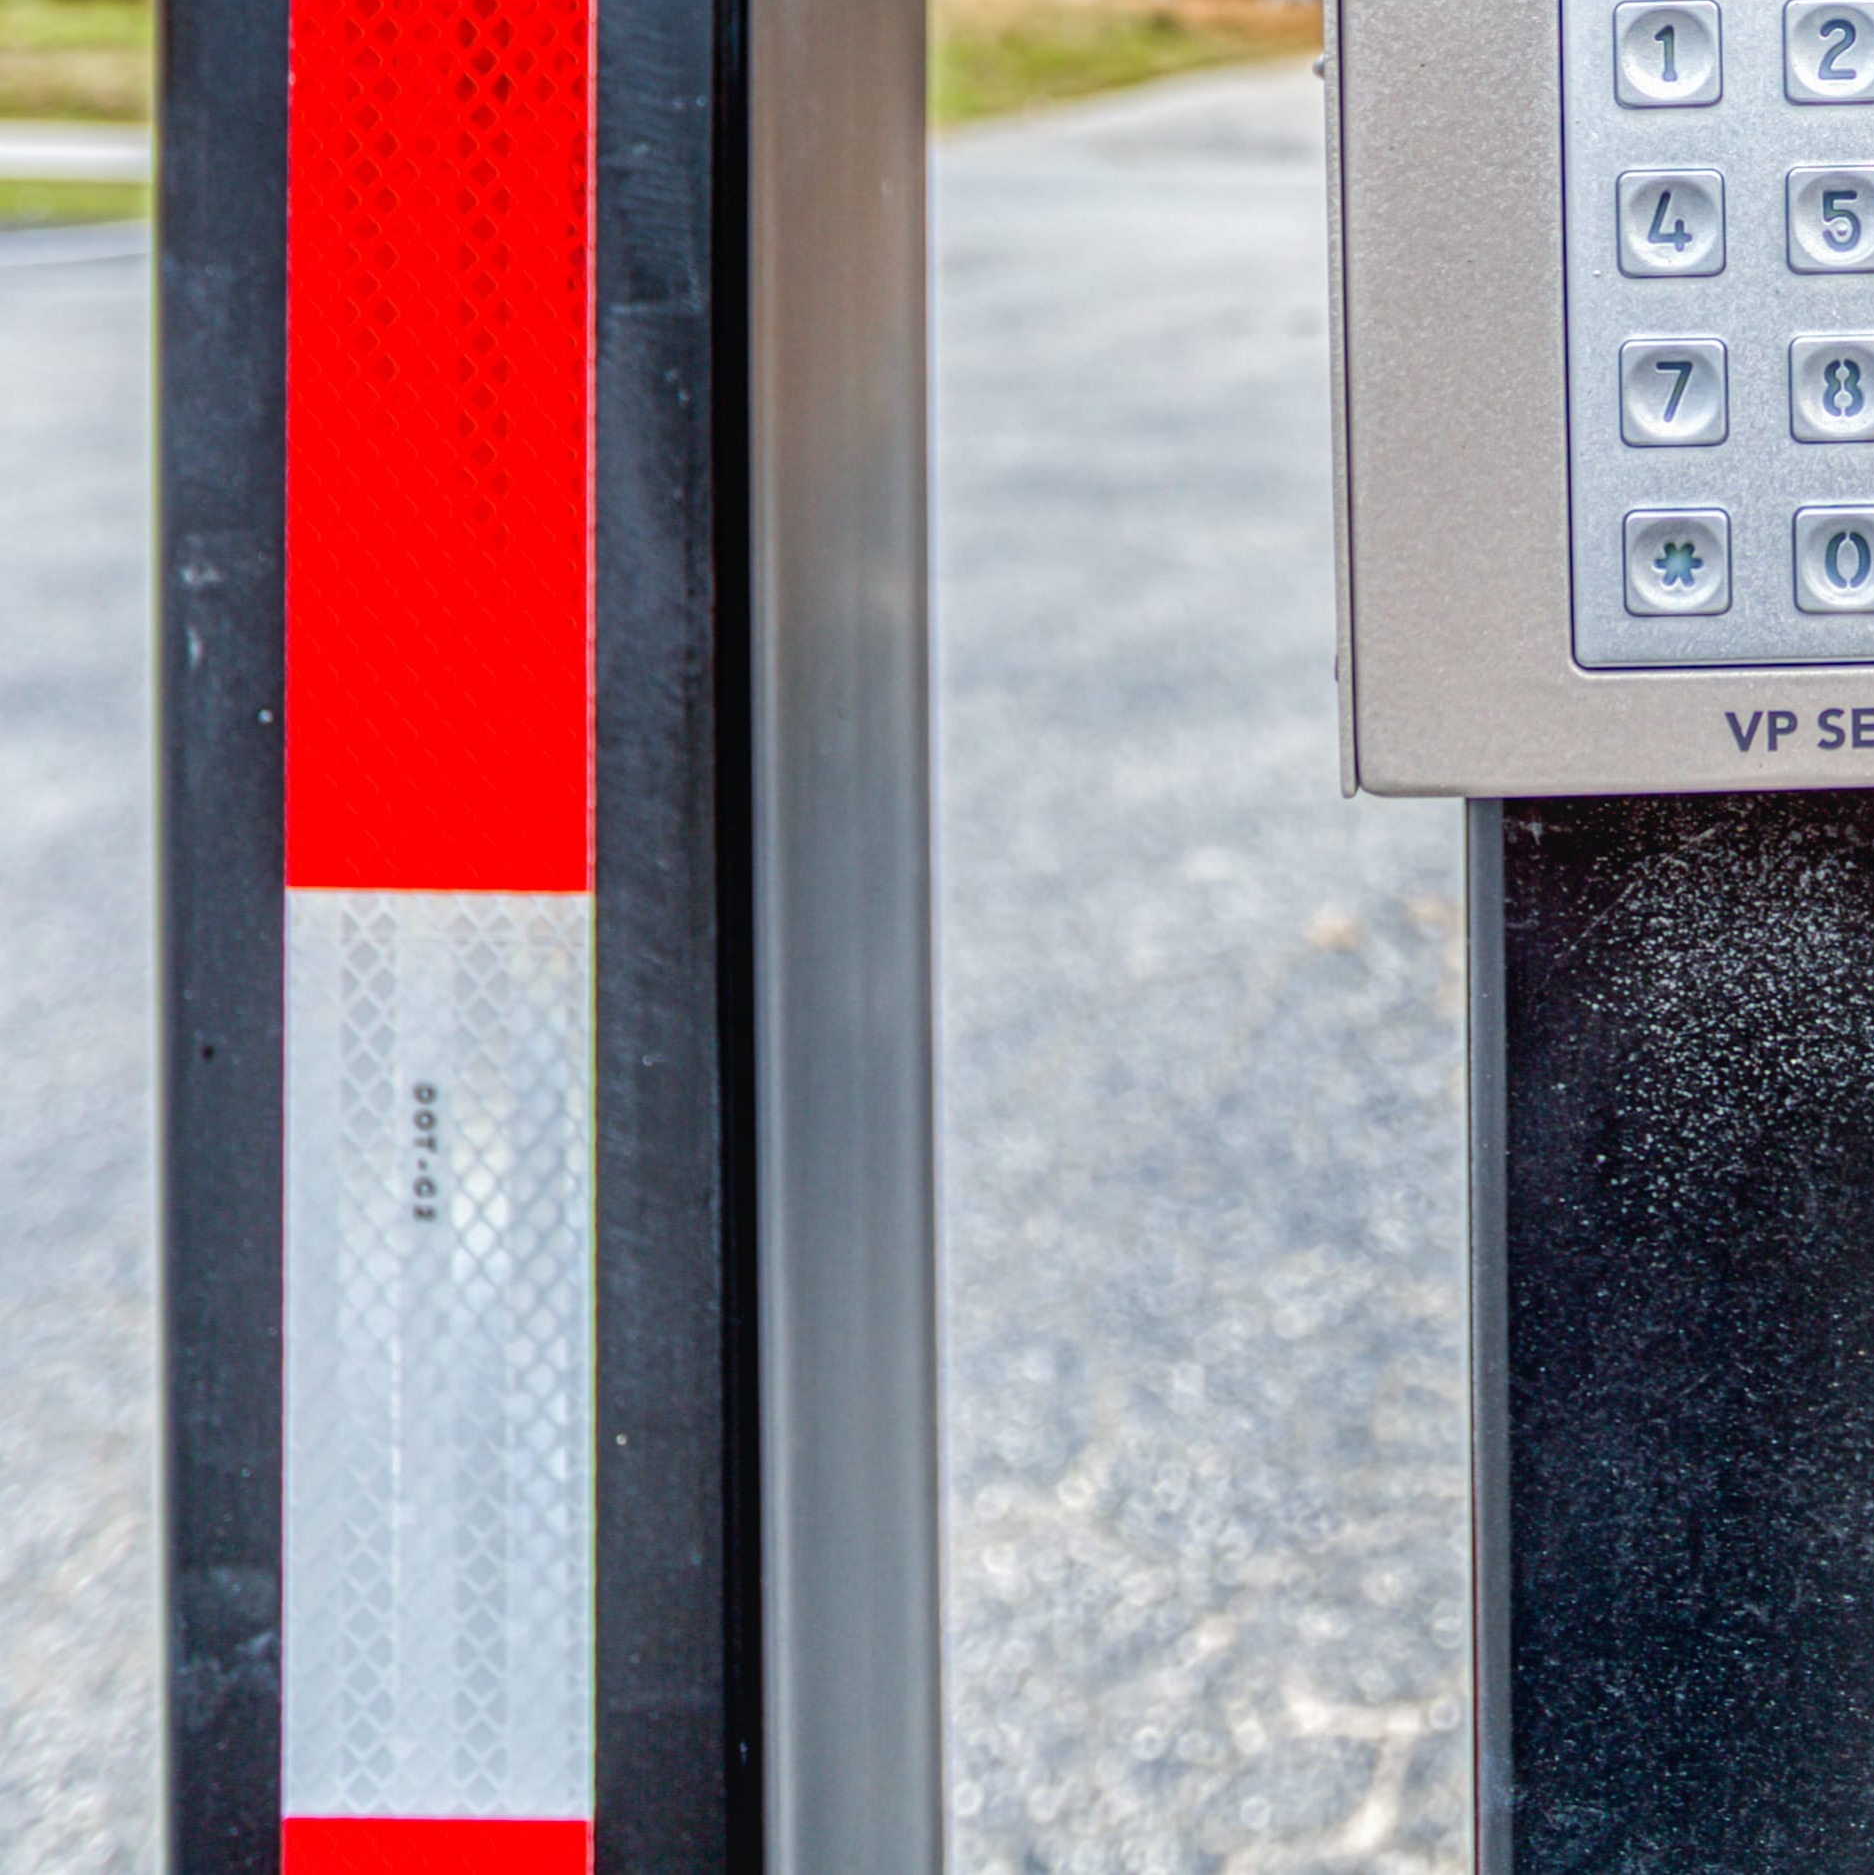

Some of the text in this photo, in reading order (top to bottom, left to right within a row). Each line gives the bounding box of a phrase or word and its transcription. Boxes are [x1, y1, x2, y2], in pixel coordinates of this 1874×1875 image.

[1655, 25, 1678, 82] 1
[1817, 19, 1856, 80] 2
[1647, 191, 1693, 252] 4
[1821, 190, 1861, 252] 5
[1654, 360, 1693, 422] 7
[1823, 358, 1864, 418] 8
[1824, 530, 1871, 589] 0
[1725, 710, 1798, 752] VP
[412, 1082, 438, 1224] DOT-C2
